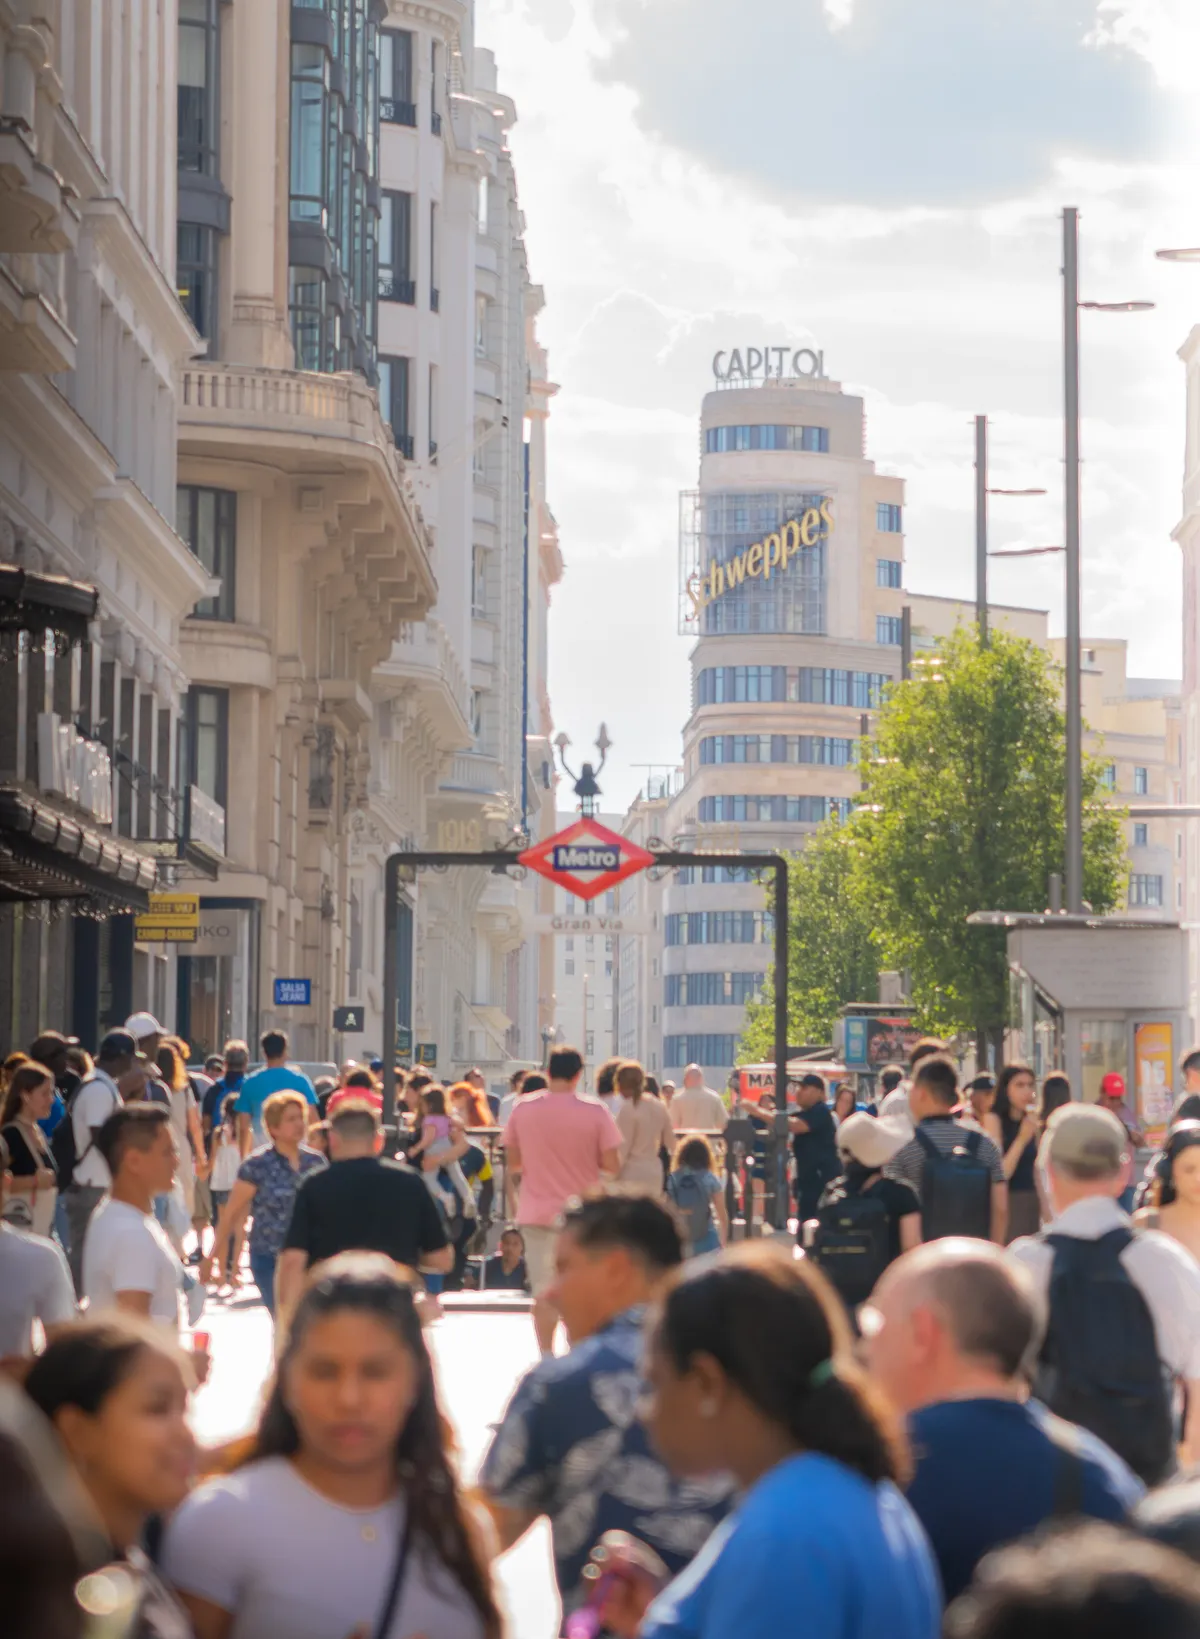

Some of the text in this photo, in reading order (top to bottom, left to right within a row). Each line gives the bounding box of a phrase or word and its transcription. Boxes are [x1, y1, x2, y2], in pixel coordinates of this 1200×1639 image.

[712, 346, 829, 380] CAPITOL
[684, 497, 834, 622] Schweppes
[557, 847, 617, 868] Metro
[551, 916, 591, 930] Gran
[748, 1073, 776, 1087] MA
